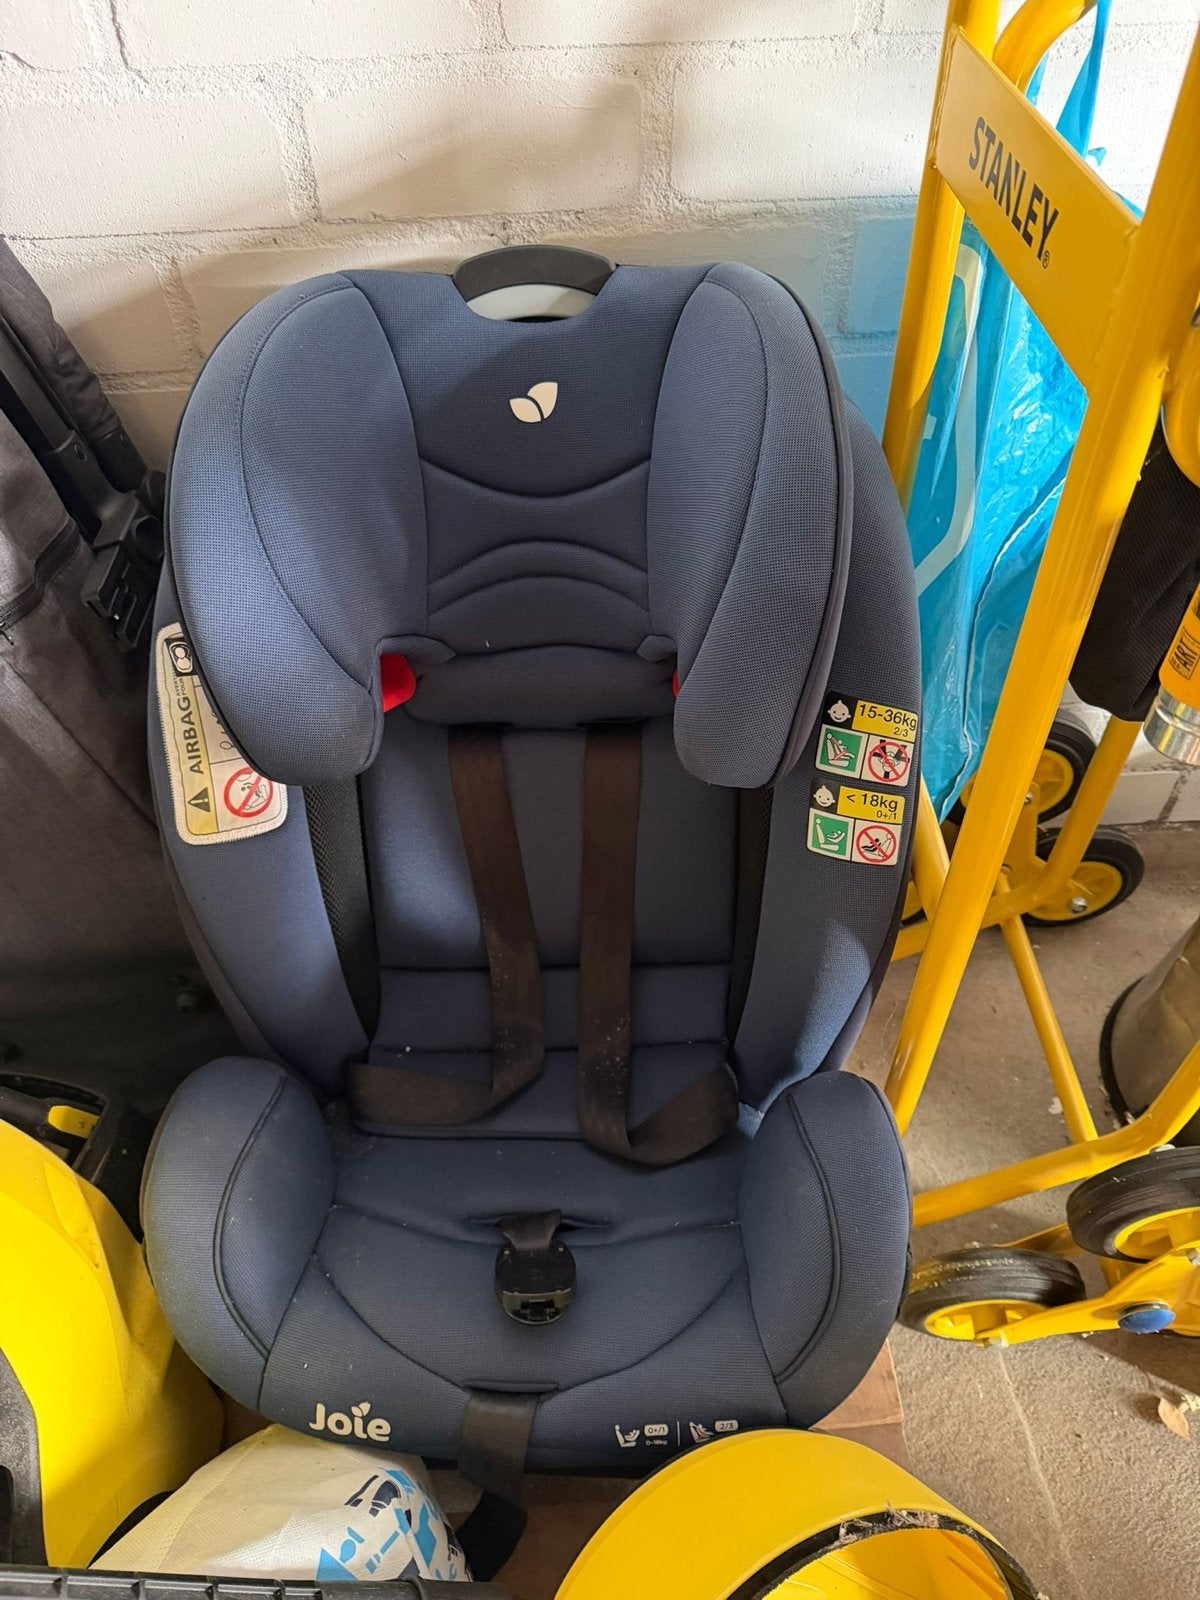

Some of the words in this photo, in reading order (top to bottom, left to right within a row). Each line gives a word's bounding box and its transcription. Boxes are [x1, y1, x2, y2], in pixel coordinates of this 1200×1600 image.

[860, 704, 917, 731] 15-36kg
[177, 697, 204, 774] AIRBAG
[893, 727, 908, 737] 2/3
[861, 793, 898, 812] 18kg
[876, 810, 897, 820] 0+/1
[309, 1401, 391, 1441] Joie
